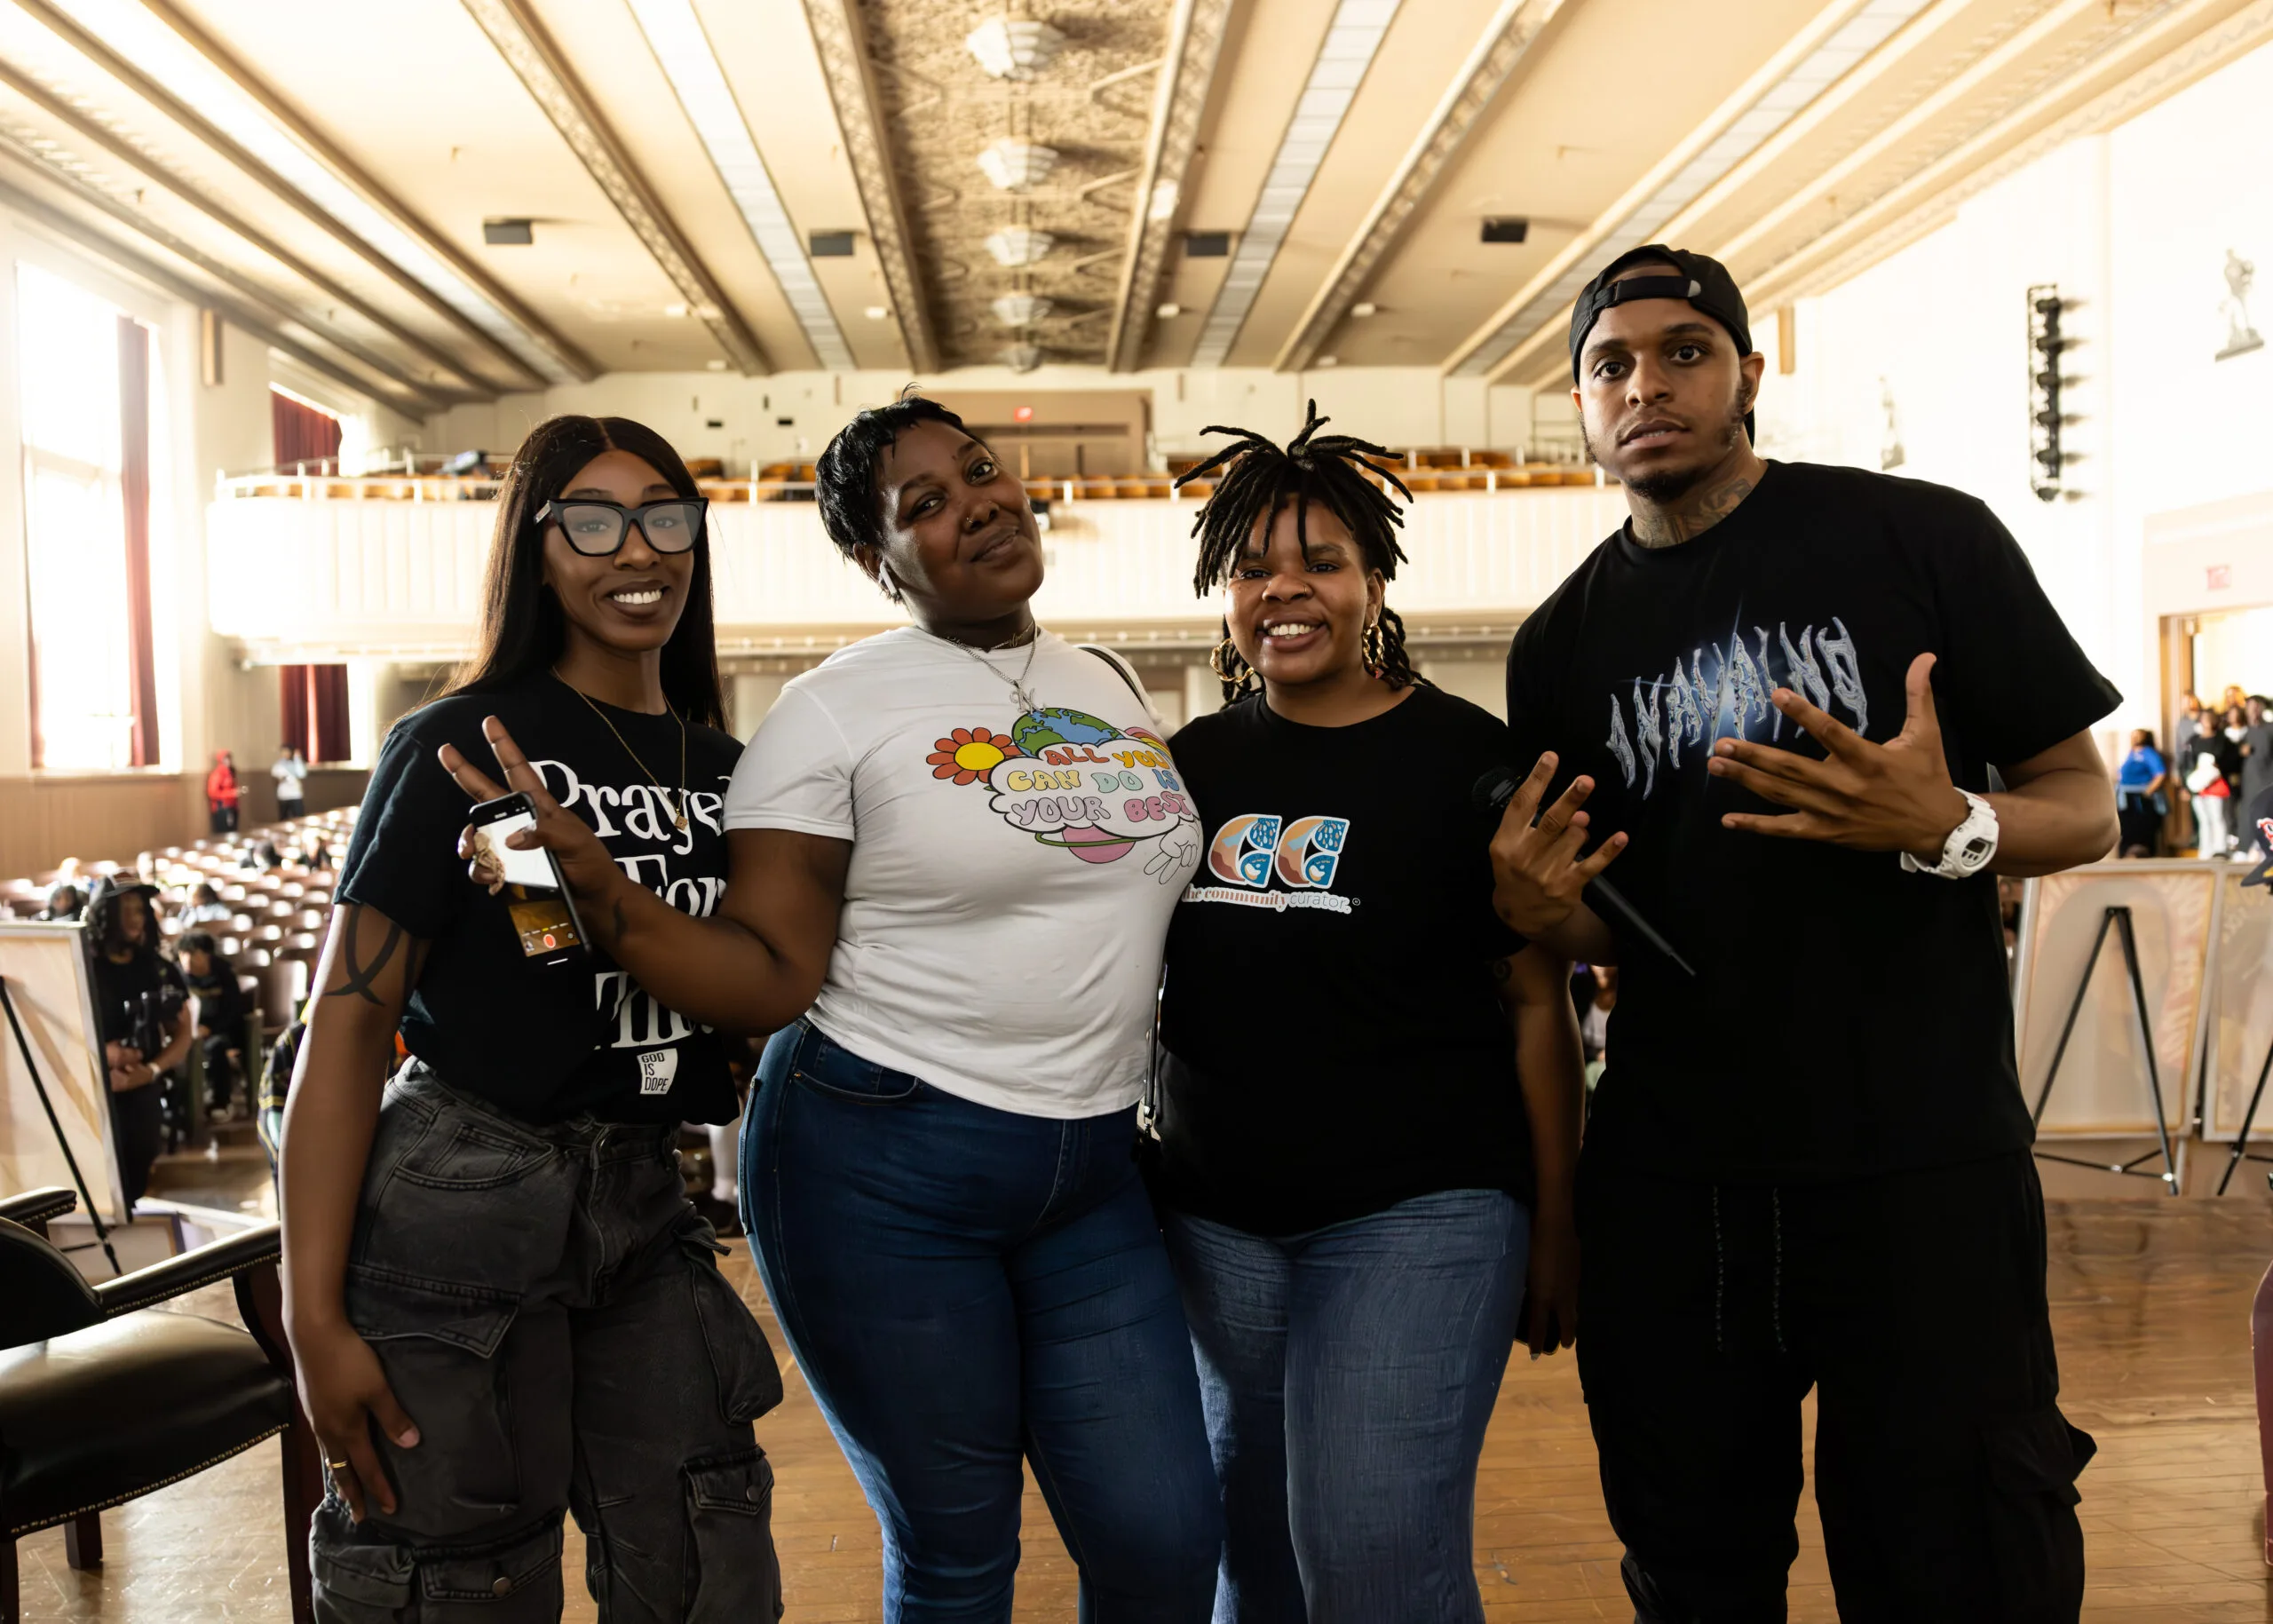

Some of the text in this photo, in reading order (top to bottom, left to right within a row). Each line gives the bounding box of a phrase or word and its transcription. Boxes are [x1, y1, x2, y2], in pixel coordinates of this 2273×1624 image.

[1044, 747, 1170, 769] ALL YOU
[1007, 768, 1180, 794] CAN DO IS
[528, 760, 728, 855] Praye
[1011, 790, 1192, 826] YOUR BEST
[641, 1051, 665, 1064] GOD
[645, 1063, 655, 1076] IS
